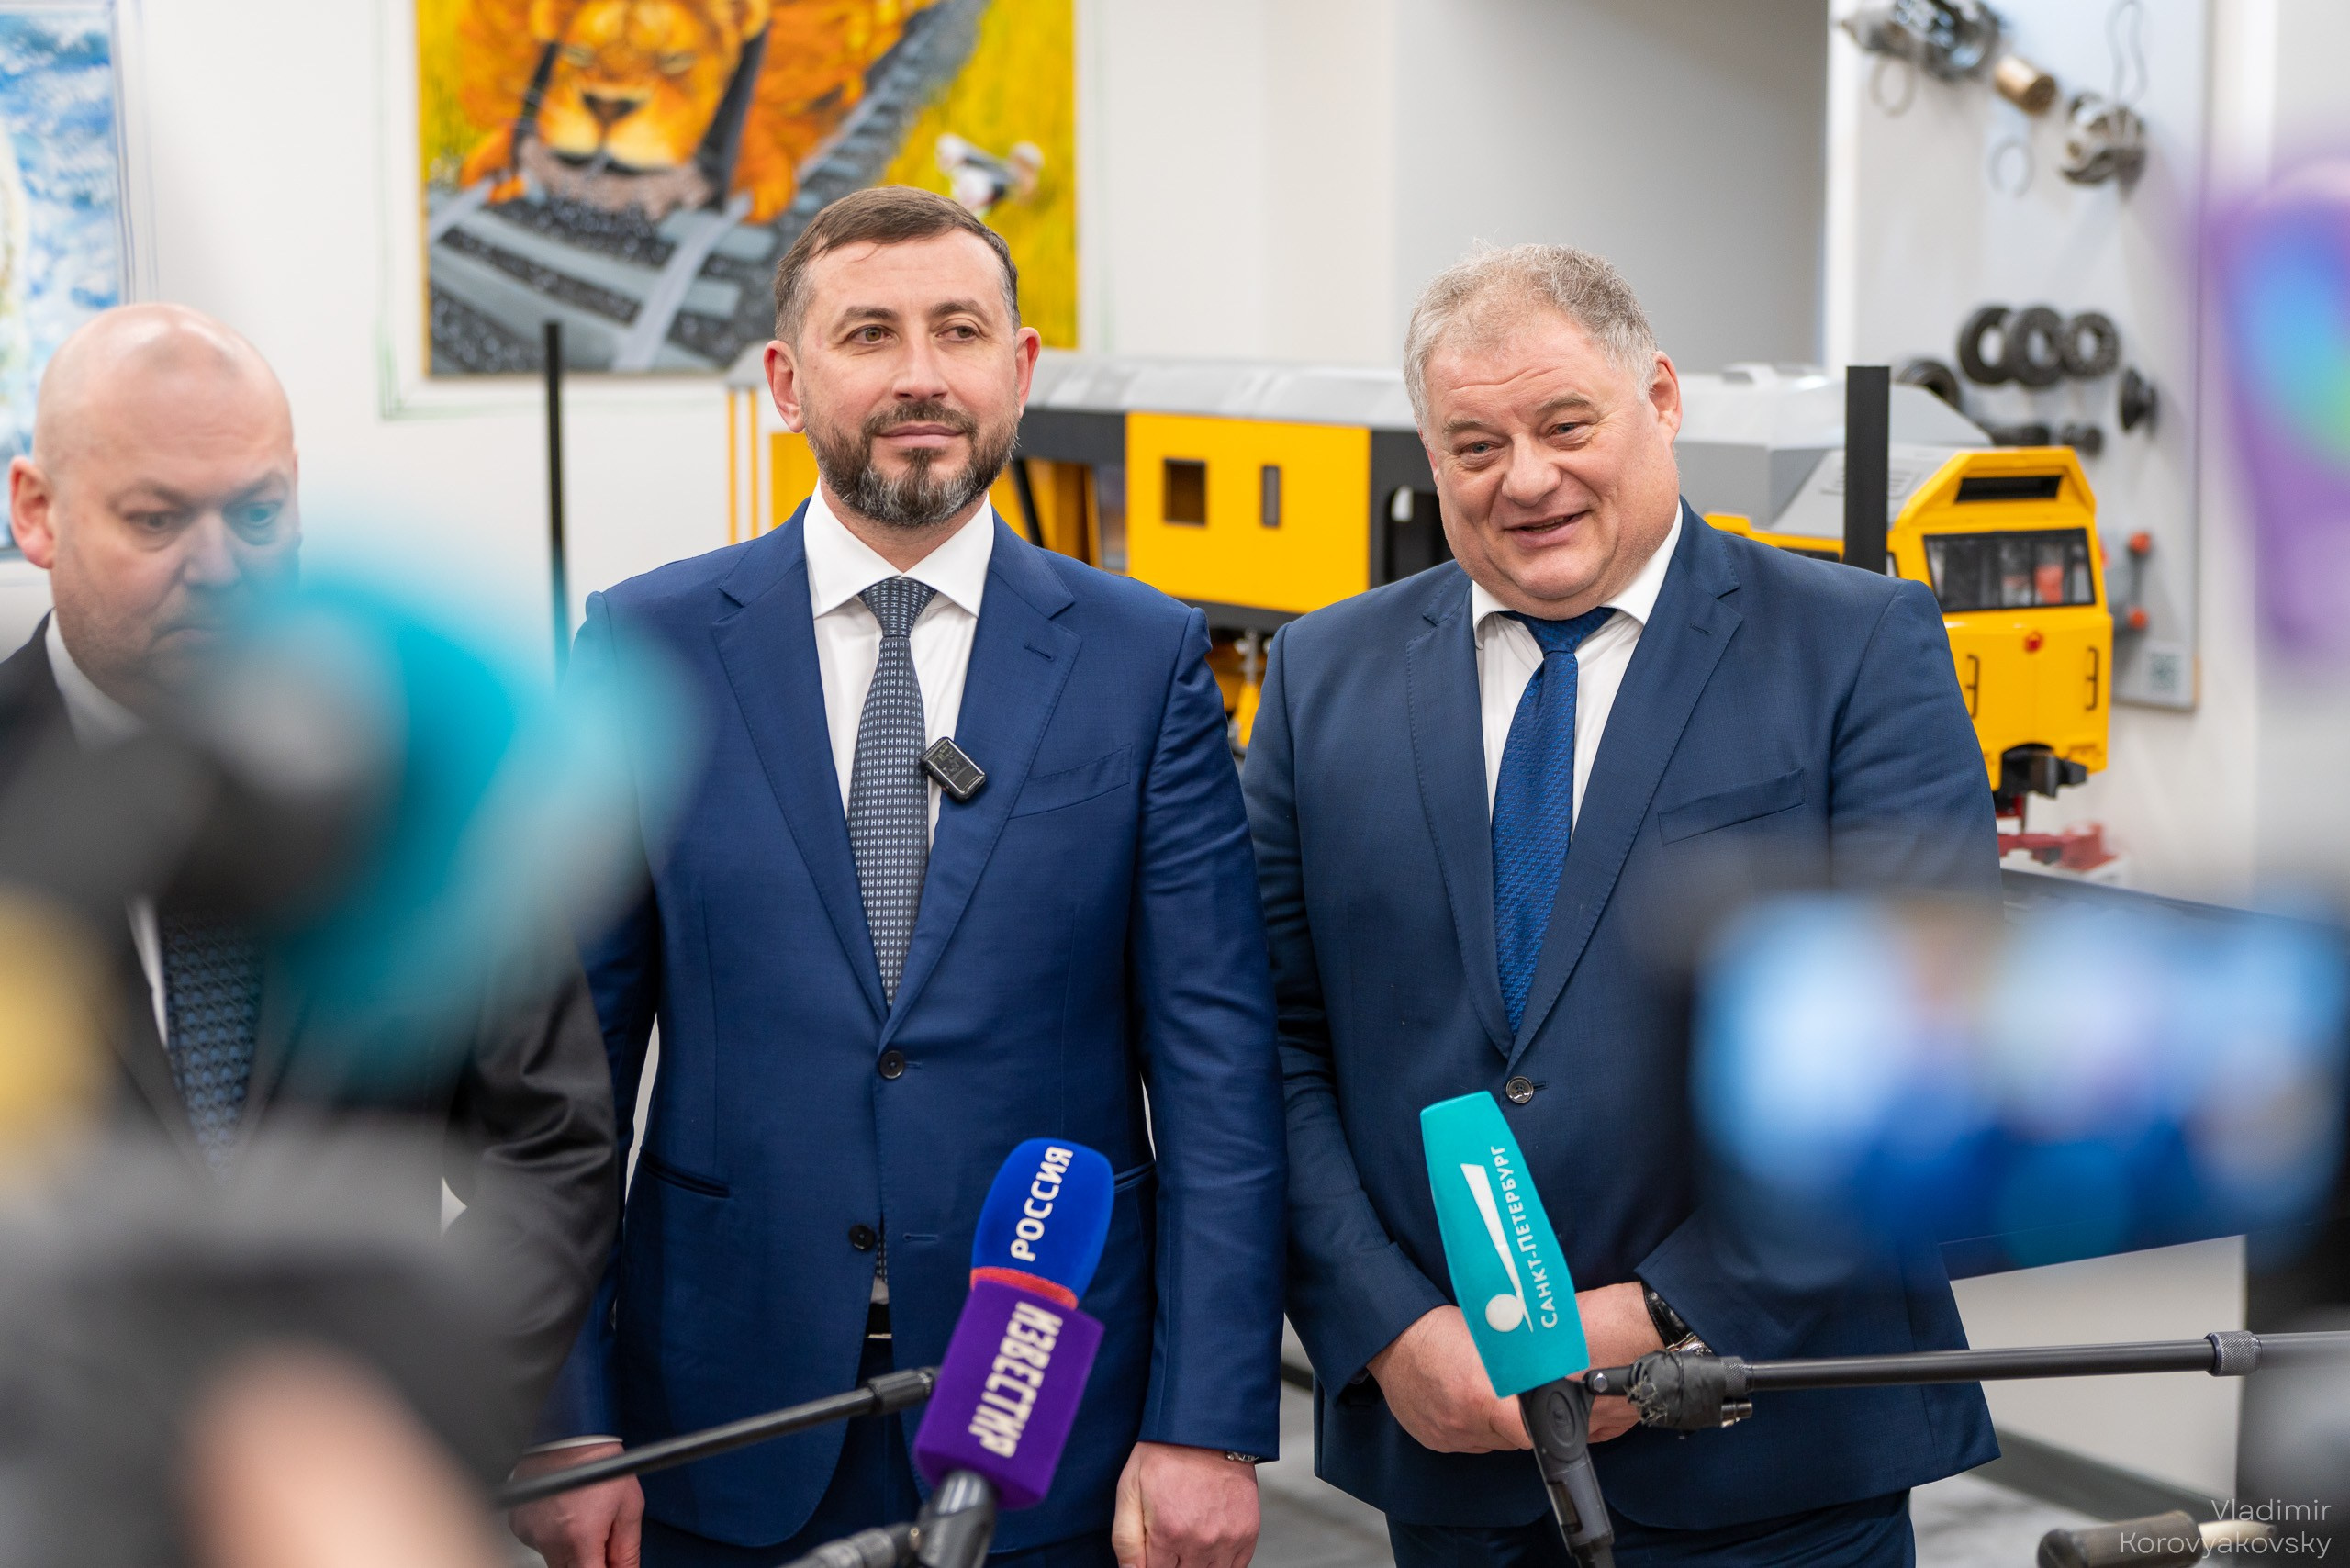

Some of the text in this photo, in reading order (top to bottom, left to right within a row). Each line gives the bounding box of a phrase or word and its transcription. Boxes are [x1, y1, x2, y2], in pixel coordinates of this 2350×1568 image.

[1010, 1146, 1074, 1263] РОССИЯ
[1490, 1145, 1559, 1329] САНКТ-ПЕТЕРБУРГ
[968, 1301, 1064, 1459] ИЗВЕСТИЯ
